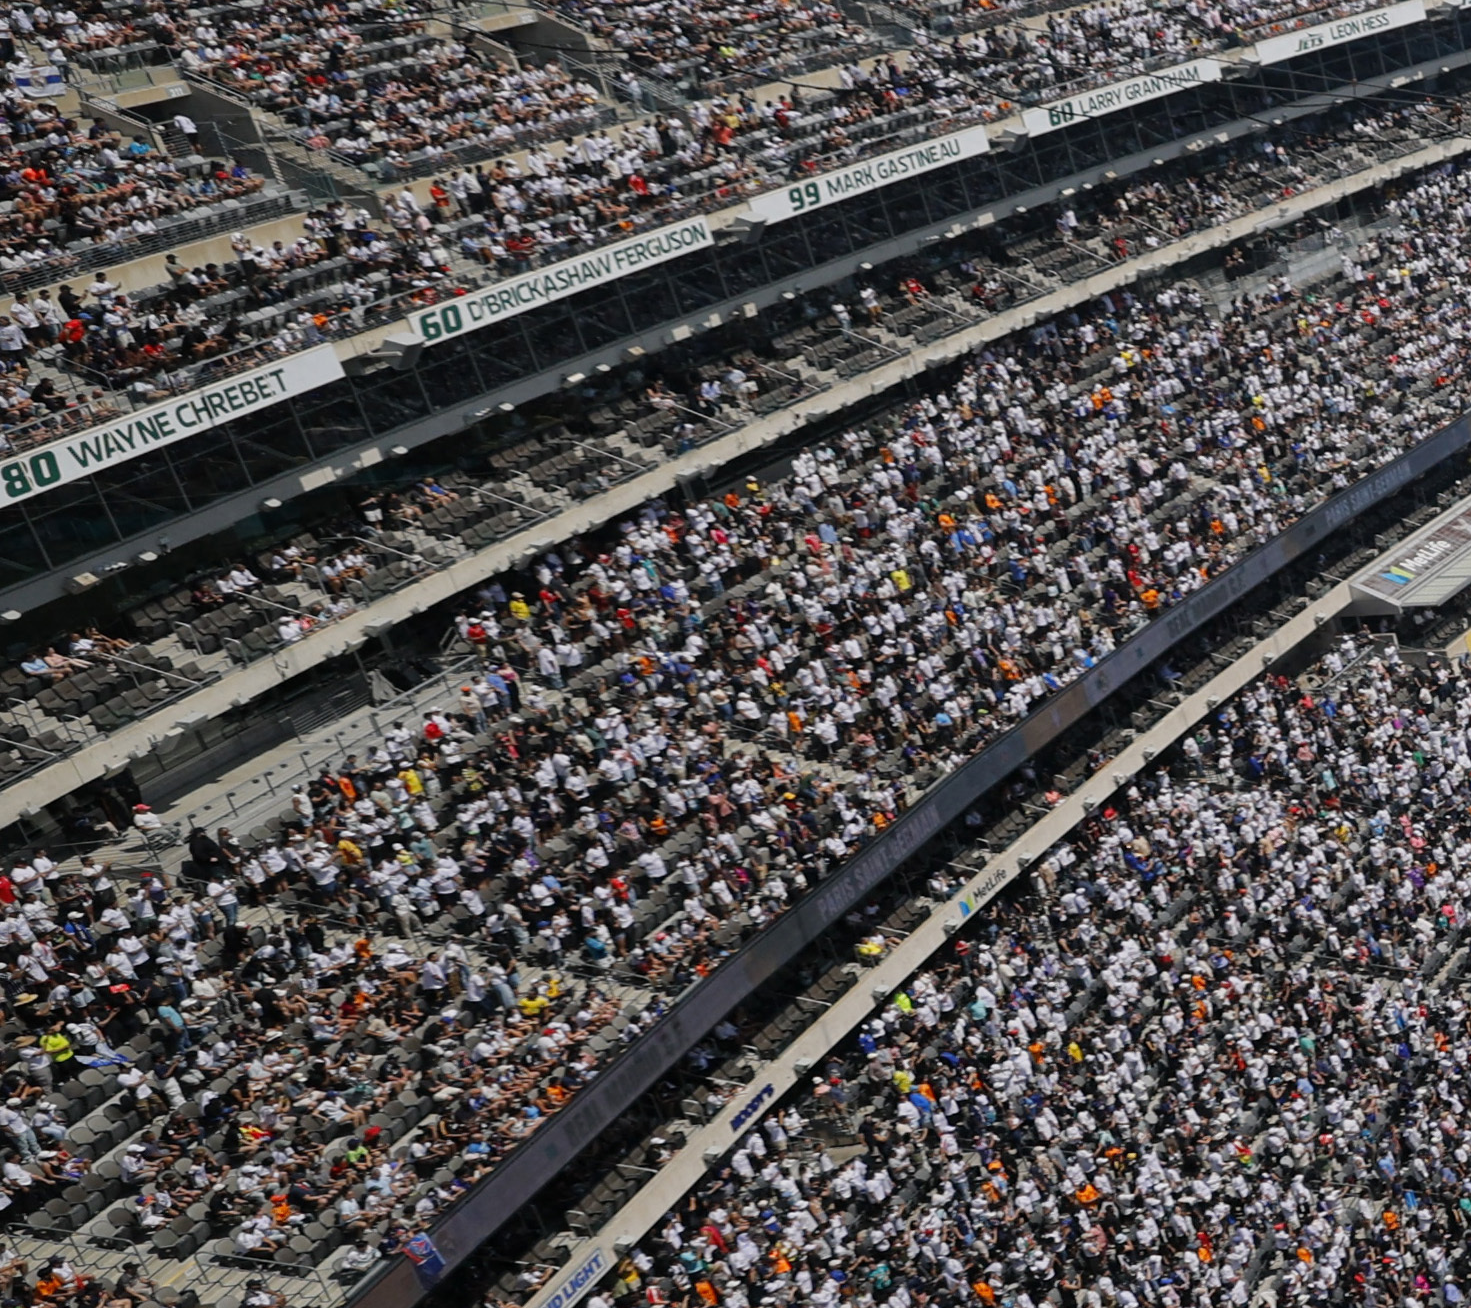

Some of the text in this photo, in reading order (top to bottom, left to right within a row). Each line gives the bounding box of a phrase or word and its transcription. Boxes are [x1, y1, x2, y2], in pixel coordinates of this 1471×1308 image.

[1329, 19, 1360, 41] LEON
[1361, 12, 1391, 33] HESS
[1078, 85, 1122, 121] LARRY
[1124, 65, 1200, 109] GRANTHAM
[788, 138, 962, 212] 99 MARK GASTINEAU
[419, 222, 709, 341] 60 D'BRICKASHAW FERGUSON
[0, 368, 288, 497] 80 WAYNE CHREBET
[1400, 540, 1451, 572] MetLife
[973, 868, 1008, 901] MetLife
[561, 1256, 601, 1299] LIGHT
